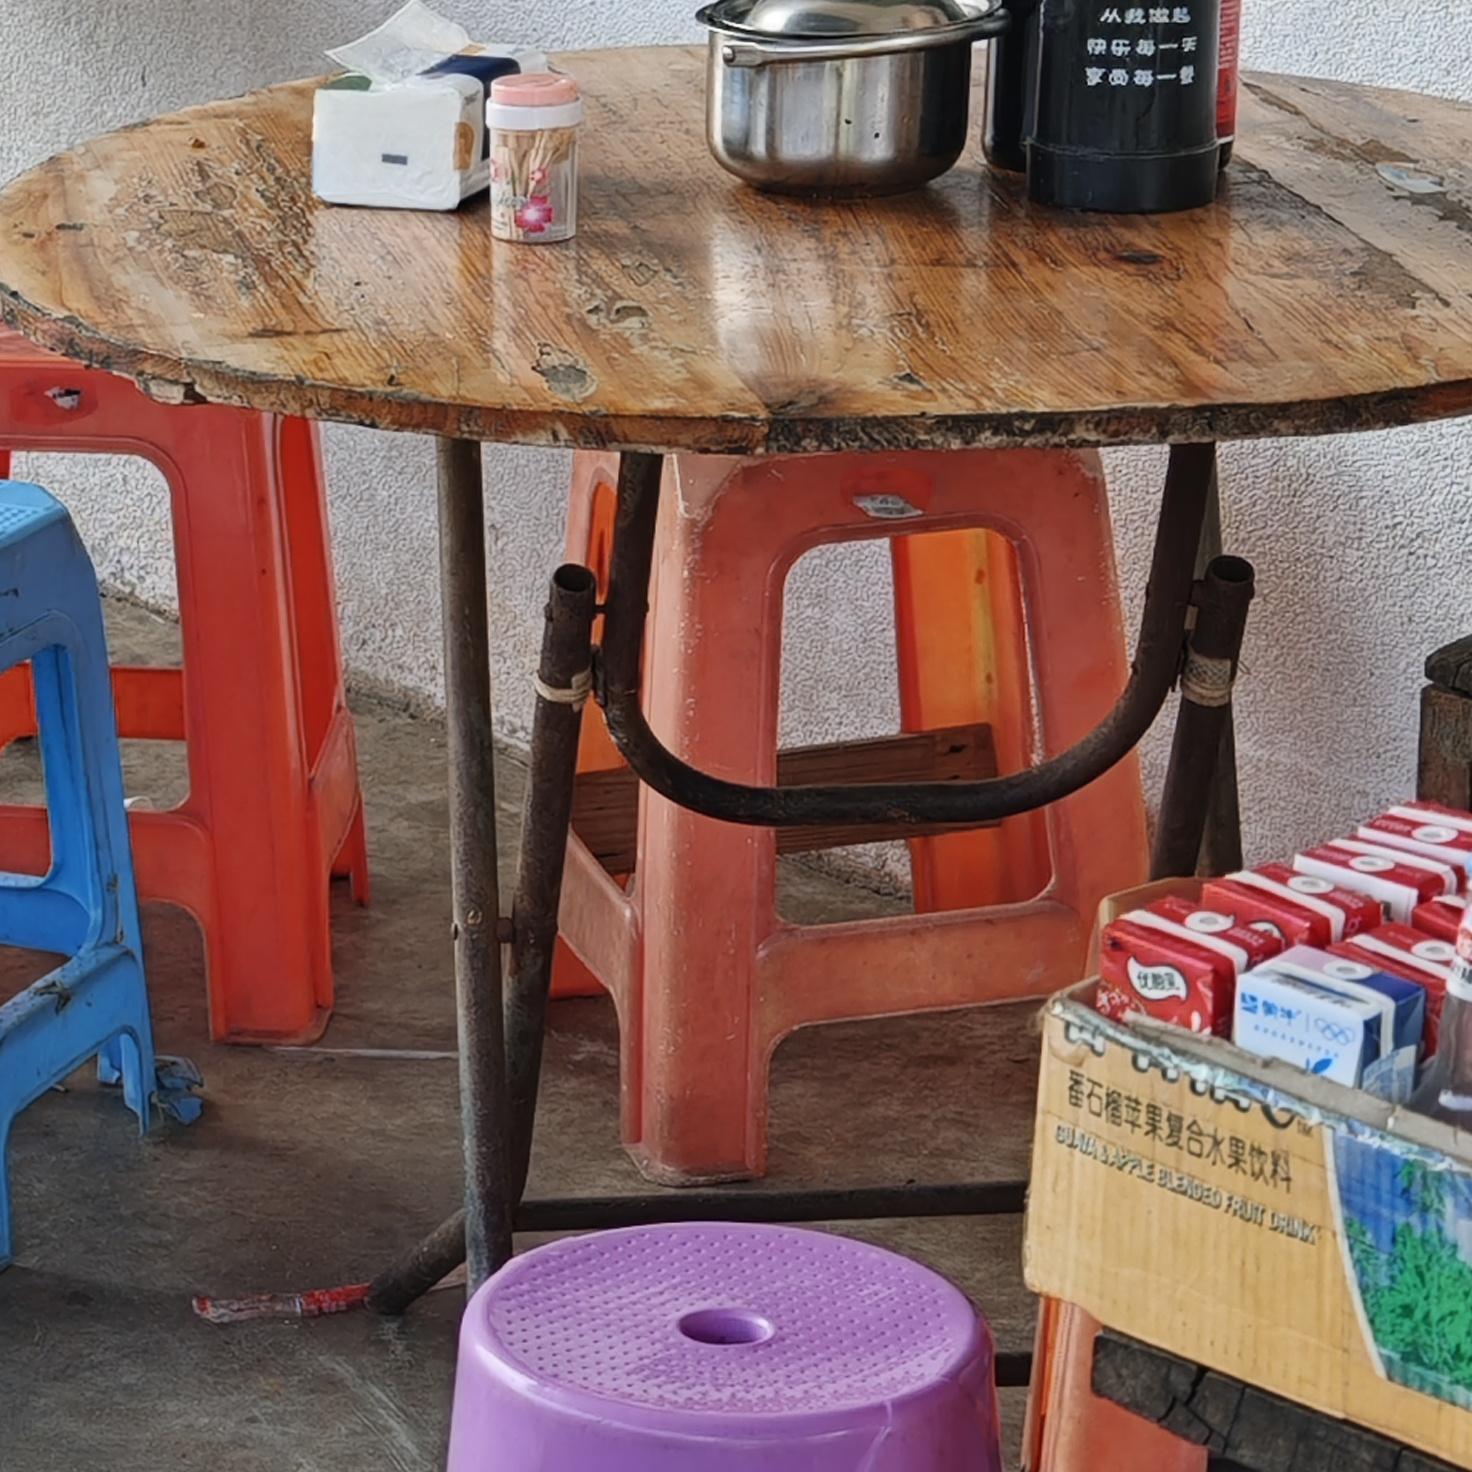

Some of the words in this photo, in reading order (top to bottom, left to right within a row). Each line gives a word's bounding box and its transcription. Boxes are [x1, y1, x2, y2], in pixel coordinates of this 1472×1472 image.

[1086, 36, 1198, 57] 快乐每一天
[1056, 1123, 1098, 1161] GUAVA
[1111, 1148, 1155, 1183] APPLE
[1157, 1167, 1223, 1210] BLENDED
[1225, 1194, 1266, 1227] FRUIT
[1270, 1211, 1322, 1245] DRINK
[1068, 1069, 1293, 1194] 番石榴苹果复合水果饮料
